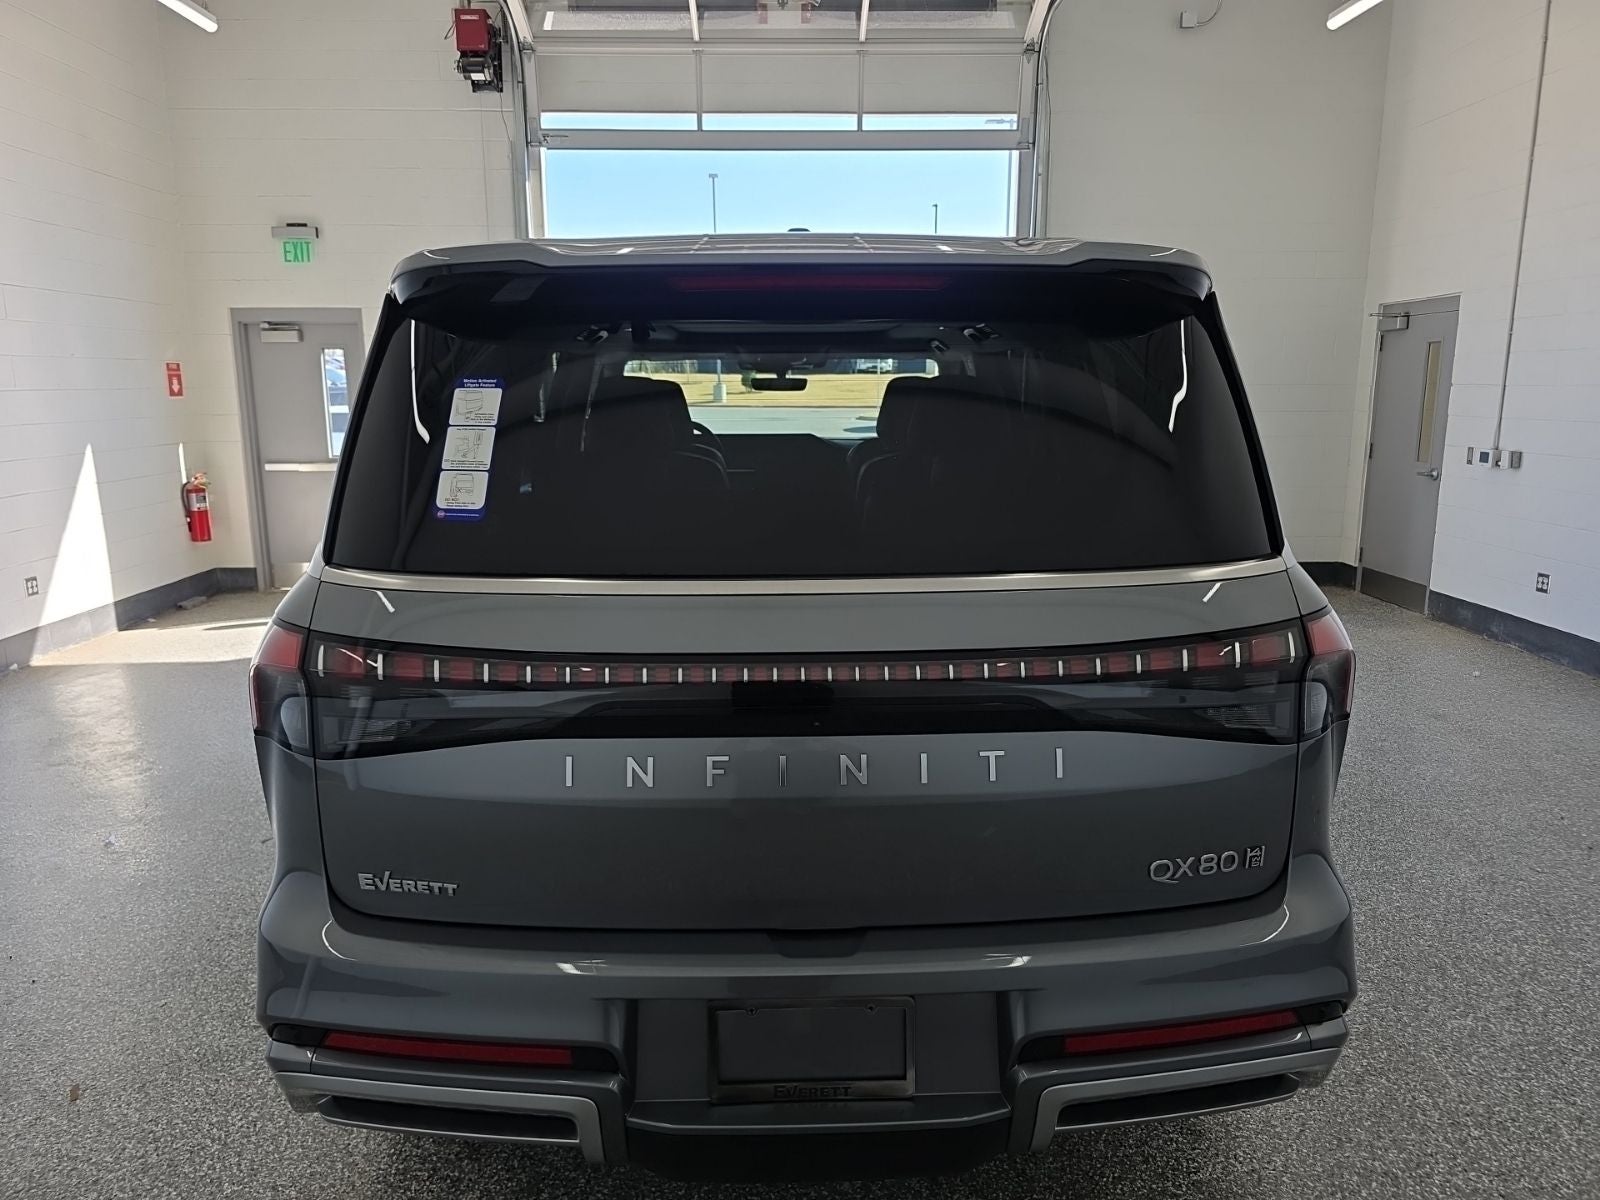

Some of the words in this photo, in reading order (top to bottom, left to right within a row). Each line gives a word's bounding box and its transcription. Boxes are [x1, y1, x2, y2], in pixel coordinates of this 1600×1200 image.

[283, 241, 311, 263] EXIT
[564, 748, 1064, 789] INFINITI
[1149, 850, 1239, 884] QX80
